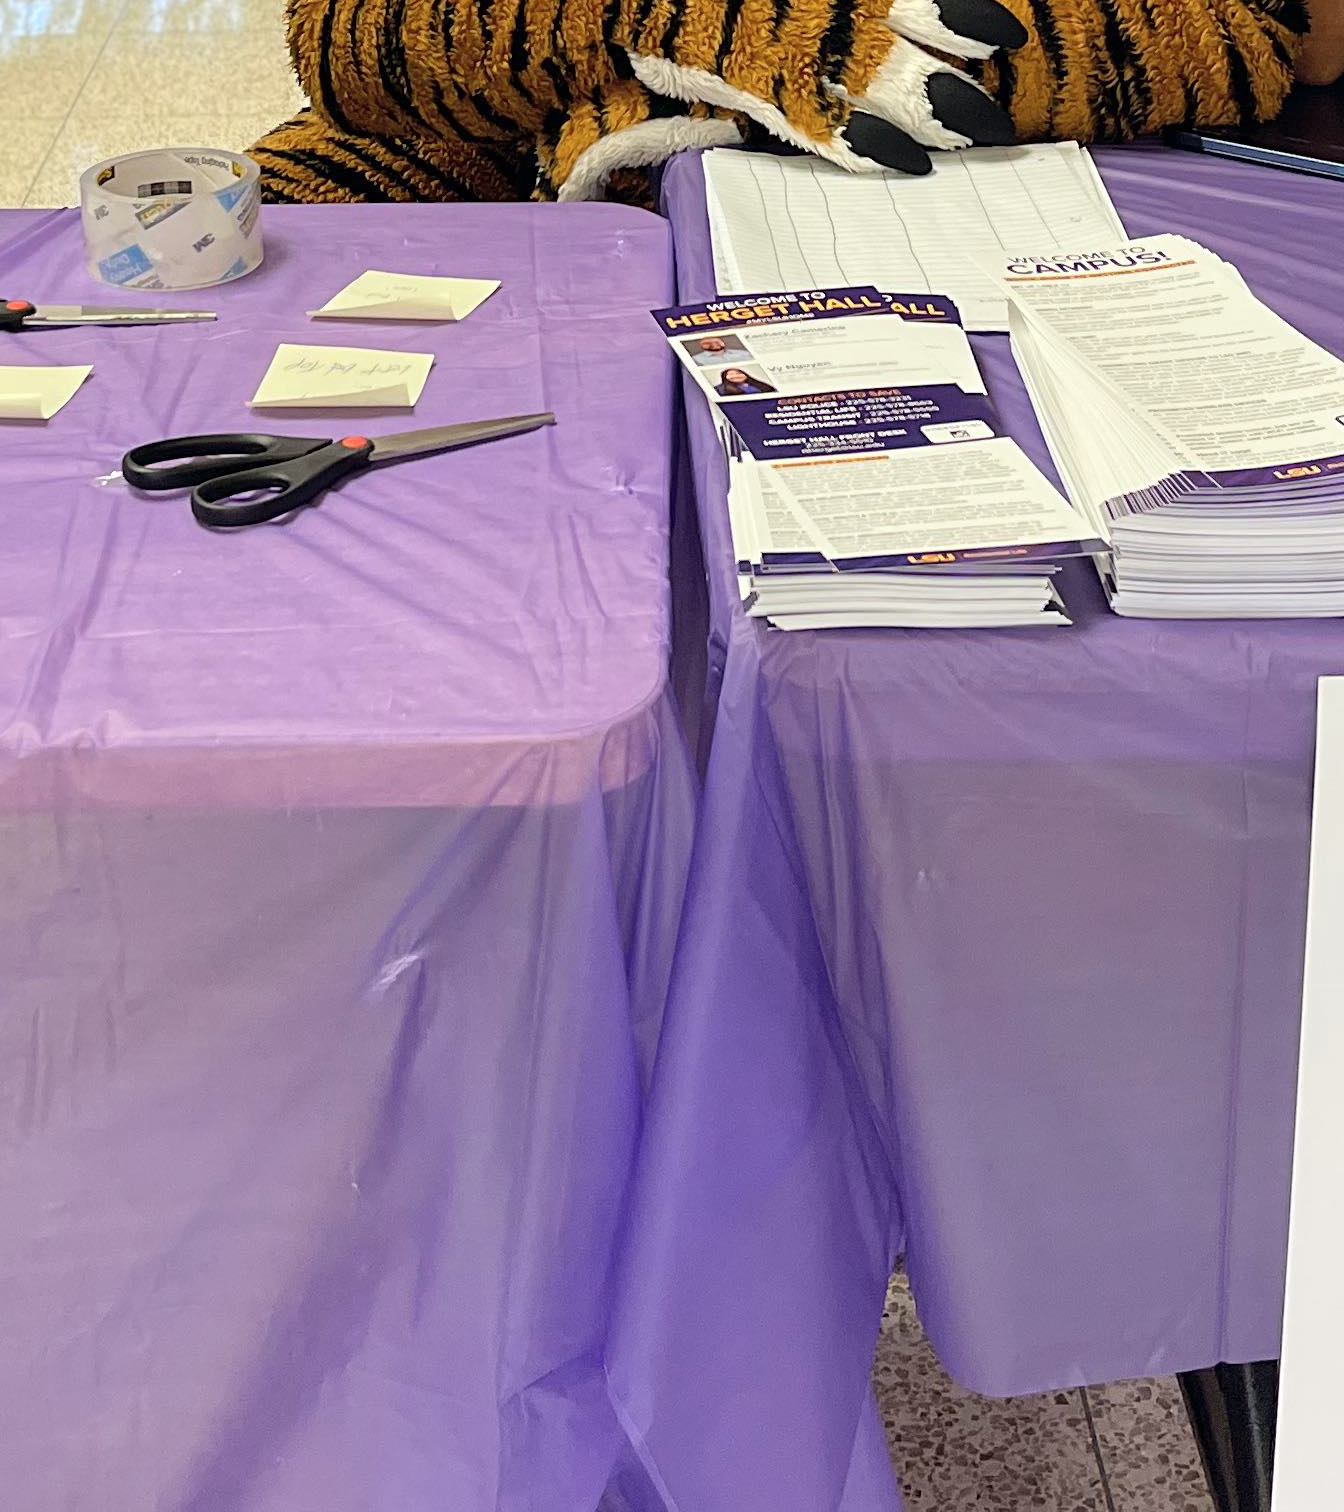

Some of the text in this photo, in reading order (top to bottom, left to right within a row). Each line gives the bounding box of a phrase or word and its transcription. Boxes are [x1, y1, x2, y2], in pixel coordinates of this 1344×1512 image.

[191, 233, 215, 253] 3M
[1006, 251, 1172, 275] CAMPUS!
[1007, 246, 1146, 265] WELCOME TO
[665, 294, 882, 329] HERGET HALL
[707, 291, 826, 312] WELCOME TO
[1273, 464, 1321, 480] LSU
